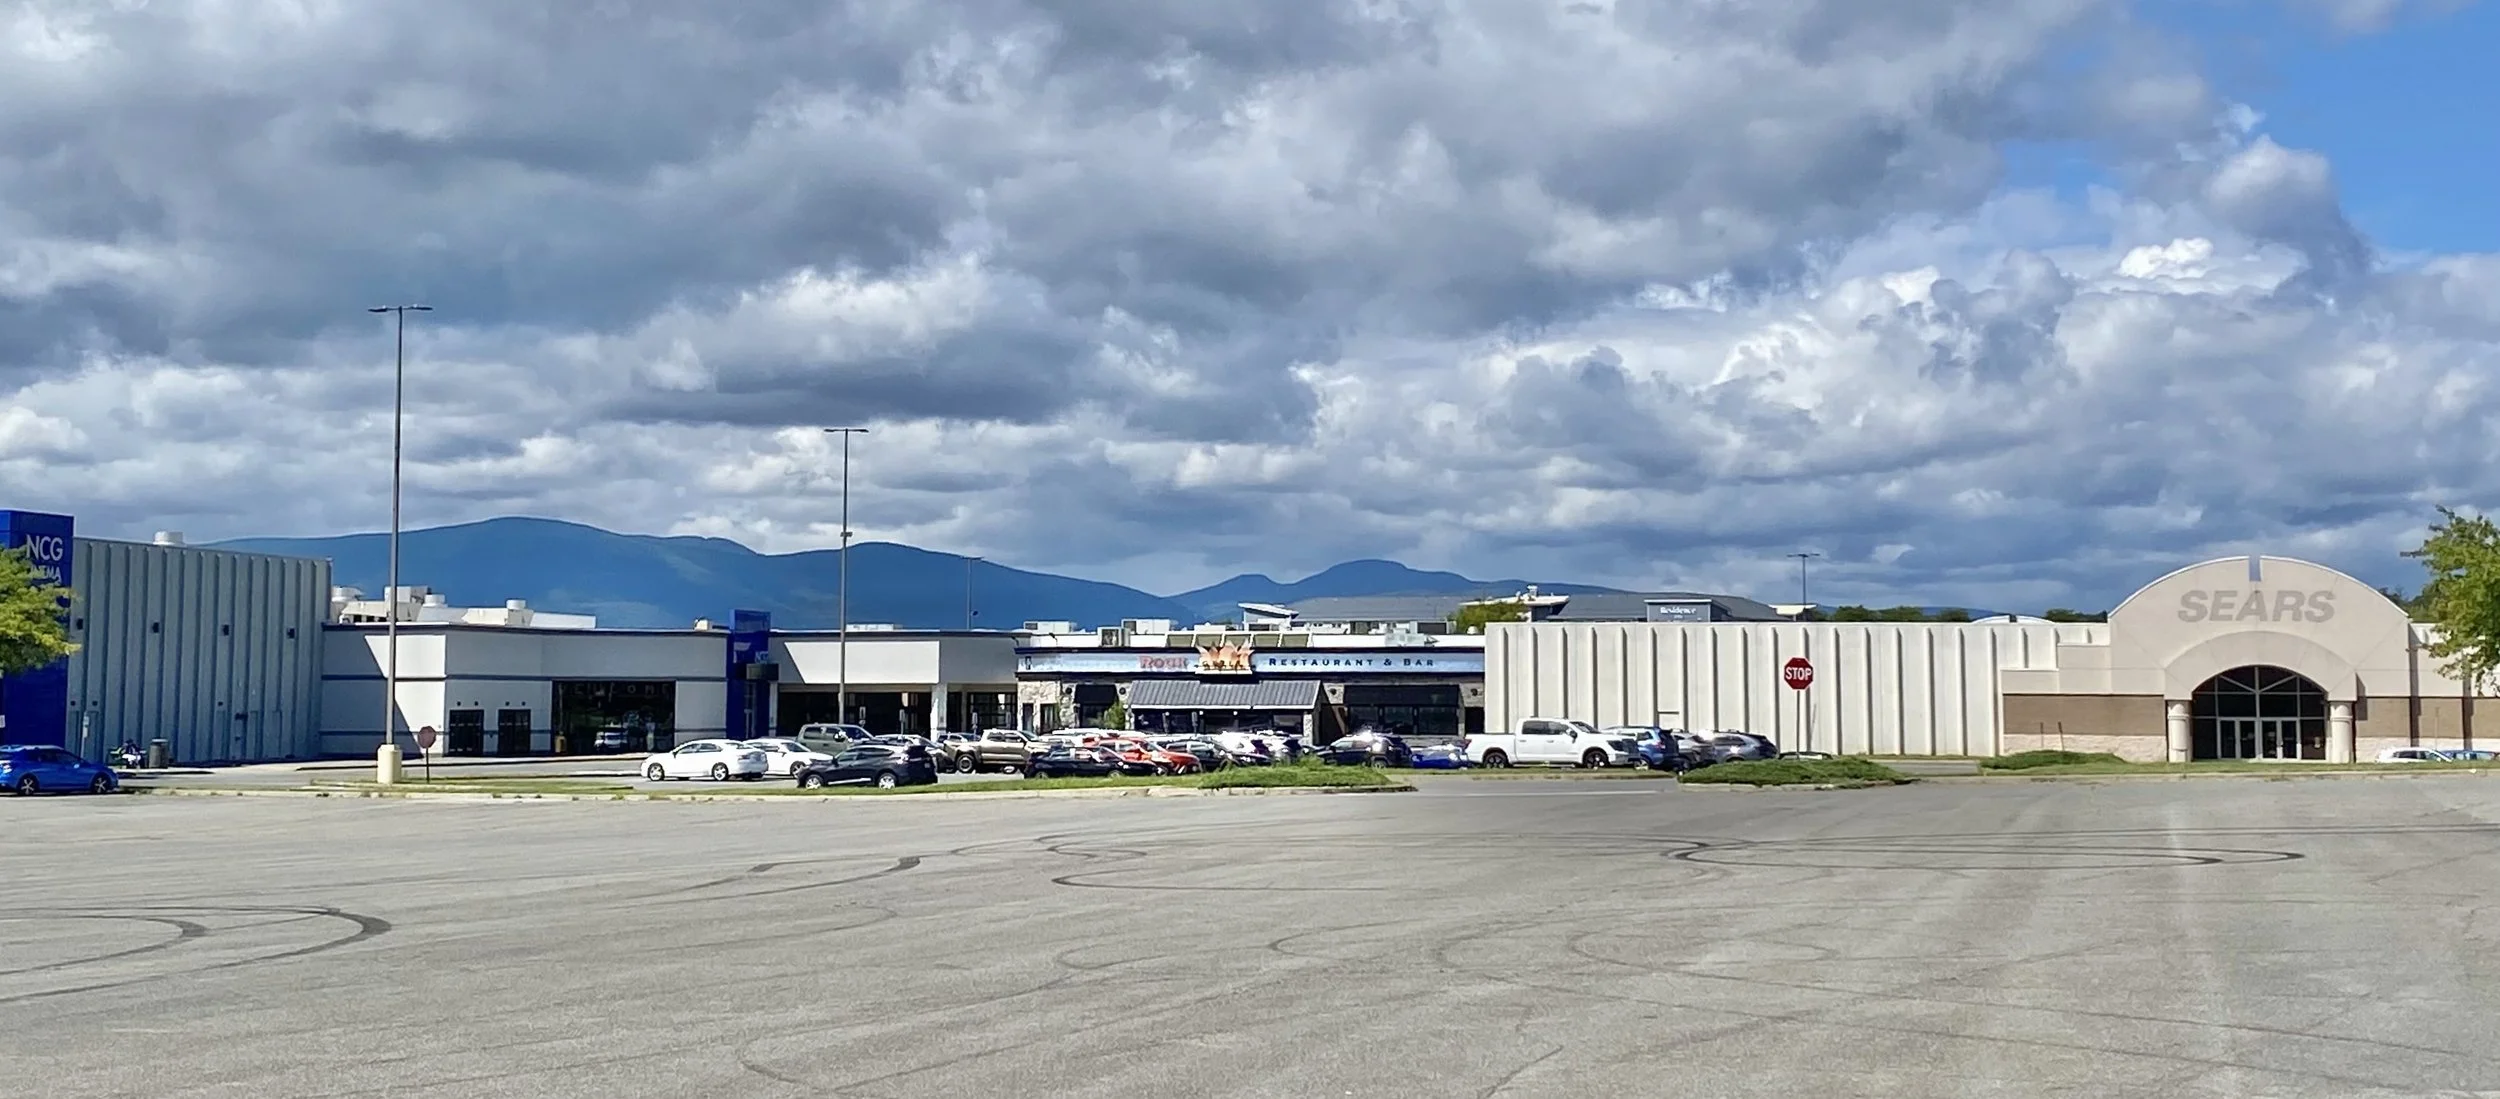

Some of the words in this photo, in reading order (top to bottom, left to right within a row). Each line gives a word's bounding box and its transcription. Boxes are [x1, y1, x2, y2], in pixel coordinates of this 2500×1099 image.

[26, 534, 63, 561] NCG
[2177, 589, 2336, 623] SEARS
[1268, 658, 1373, 666] RESTAURANT
[1383, 658, 1393, 666] &
[1403, 658, 1434, 667] BAR
[1785, 666, 1812, 680] STOP
